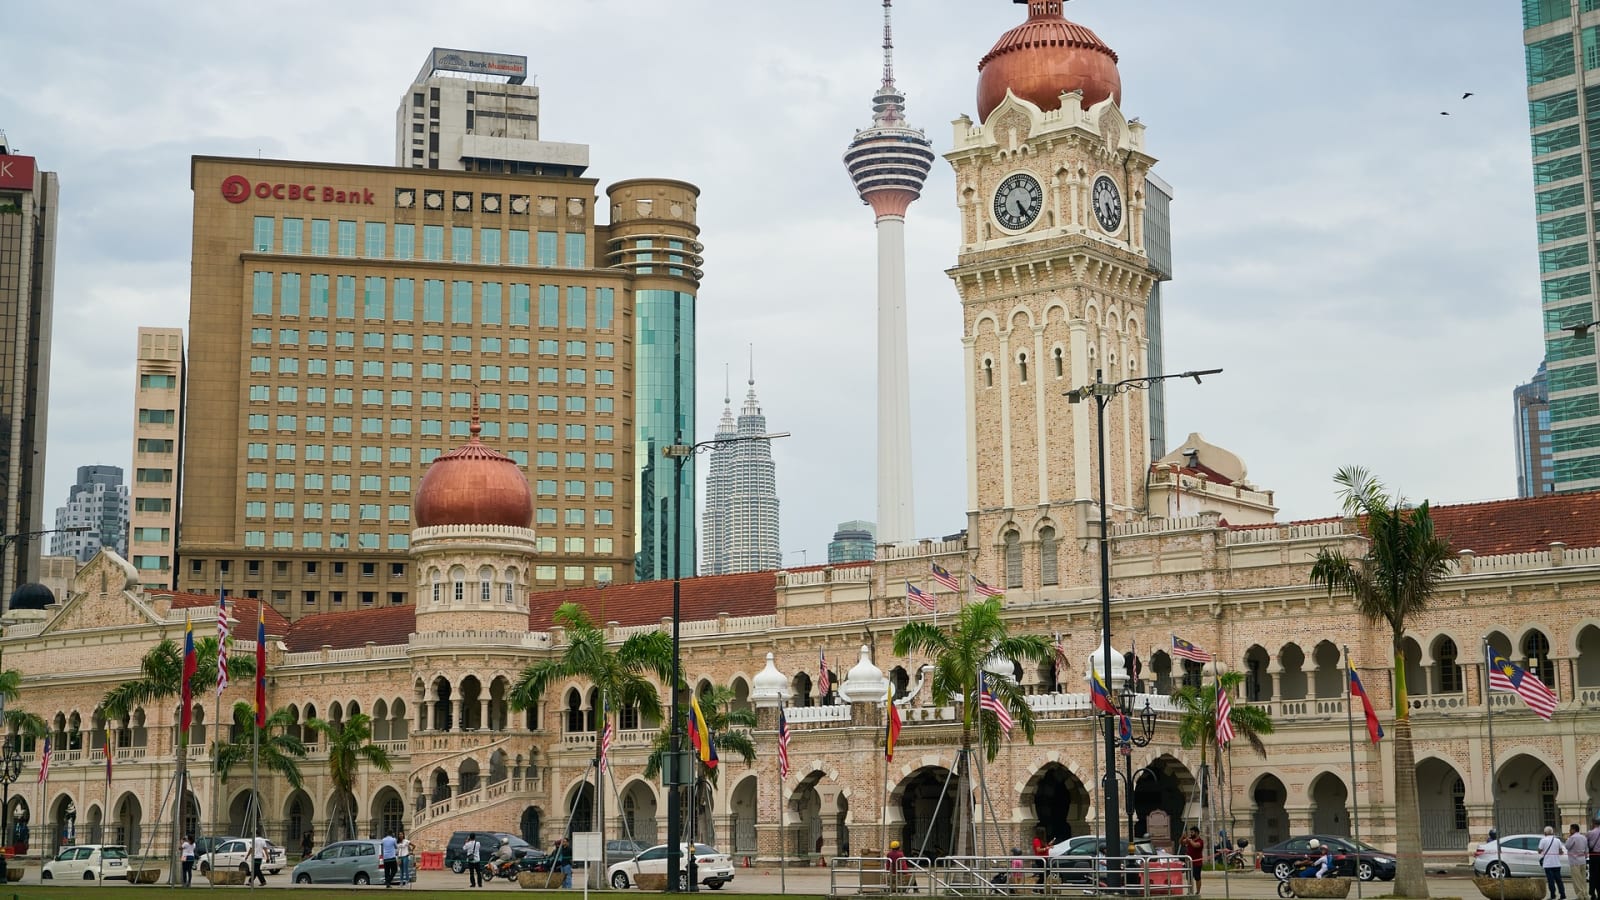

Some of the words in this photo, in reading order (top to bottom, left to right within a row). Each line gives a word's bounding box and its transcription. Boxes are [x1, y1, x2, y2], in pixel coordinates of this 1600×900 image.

[469, 60, 487, 69] Bank
[255, 182, 316, 202] OCBC
[322, 186, 375, 205] Bank
